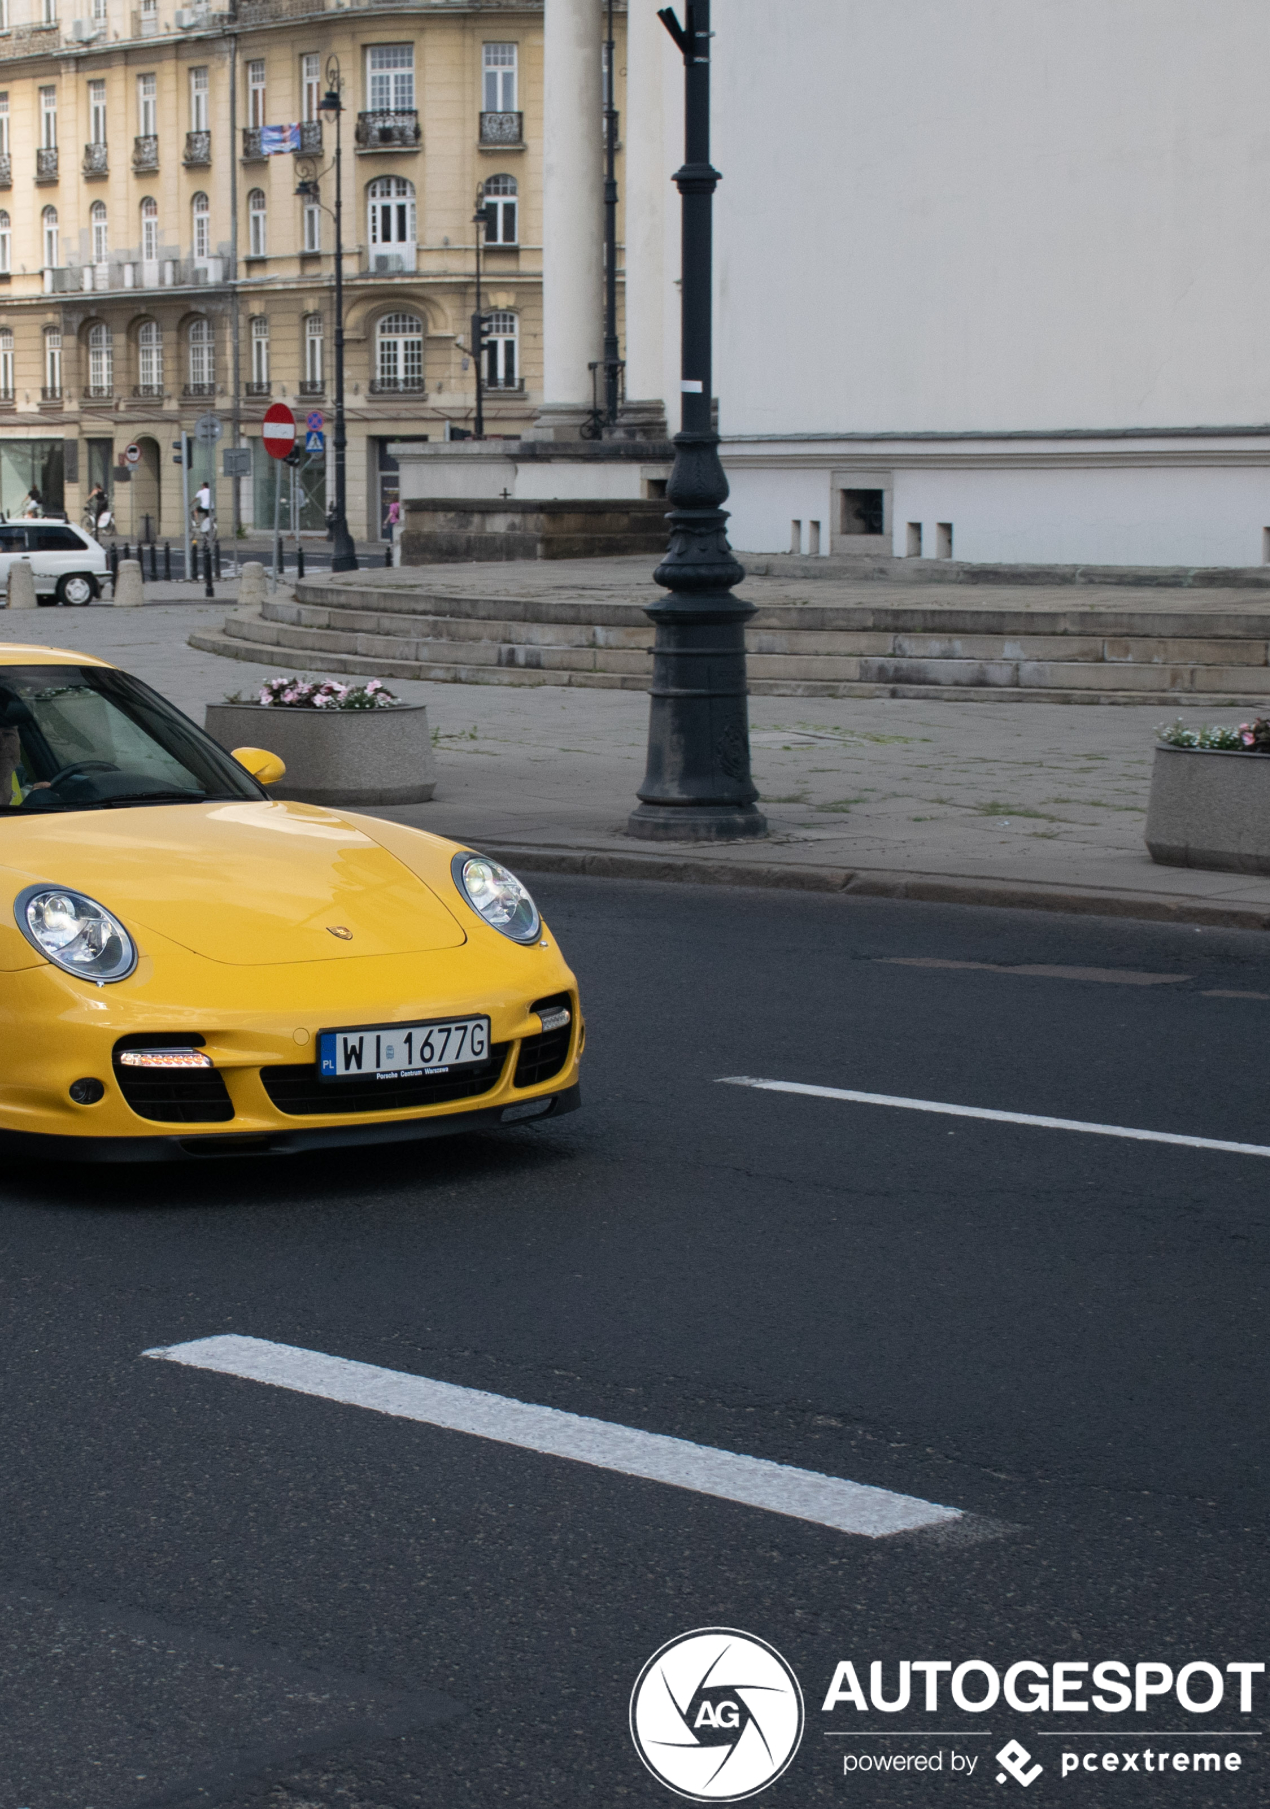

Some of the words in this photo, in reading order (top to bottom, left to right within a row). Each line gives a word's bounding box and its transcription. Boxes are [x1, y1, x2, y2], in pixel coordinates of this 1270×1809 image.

[342, 1034, 381, 1071] WI
[403, 1023, 484, 1066] 1677G
[322, 1060, 334, 1069] PL
[376, 1072, 398, 1080] Porsche
[424, 1066, 449, 1075] Warszawa
